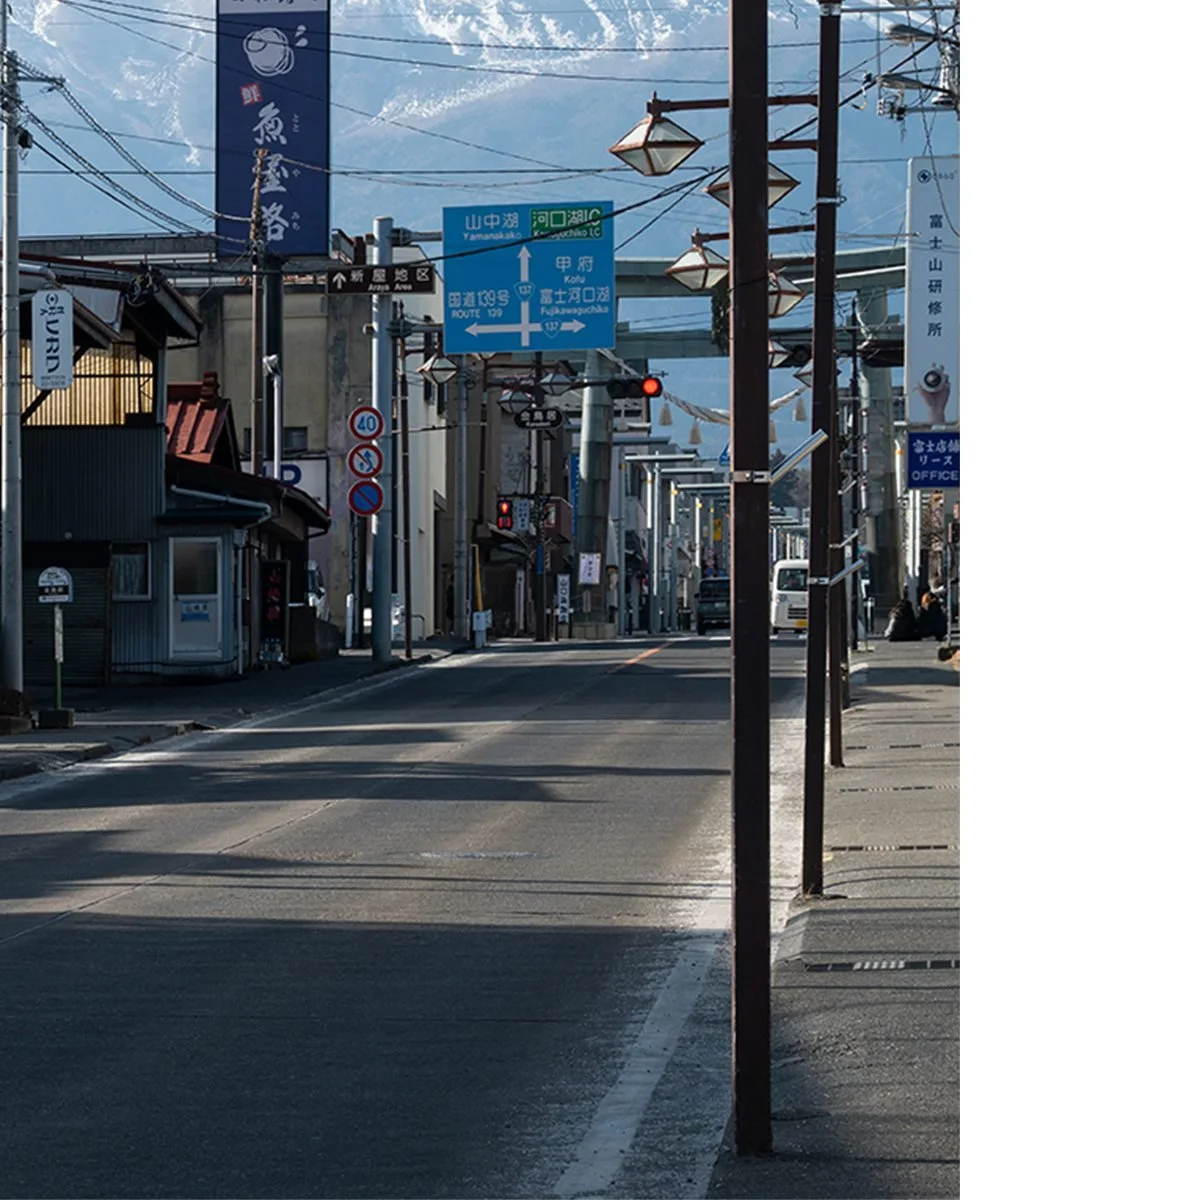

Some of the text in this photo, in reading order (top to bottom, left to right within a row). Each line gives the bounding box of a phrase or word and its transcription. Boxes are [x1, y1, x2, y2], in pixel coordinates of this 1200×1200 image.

[465, 212, 519, 230] 山中湖
[463, 232, 522, 241] Yamanakako
[556, 256, 593, 272] 甲府
[564, 275, 585, 284] Kofu
[927, 213, 943, 337] 富士山研修所
[448, 289, 510, 308] 国道139号
[540, 286, 609, 305] 富士河口湖
[451, 308, 480, 319] ROUTE
[540, 305, 609, 317] Fujikawaguchiko
[357, 415, 377, 432] 40
[919, 455, 952, 465] リース
[912, 470, 958, 481] OFFICE
